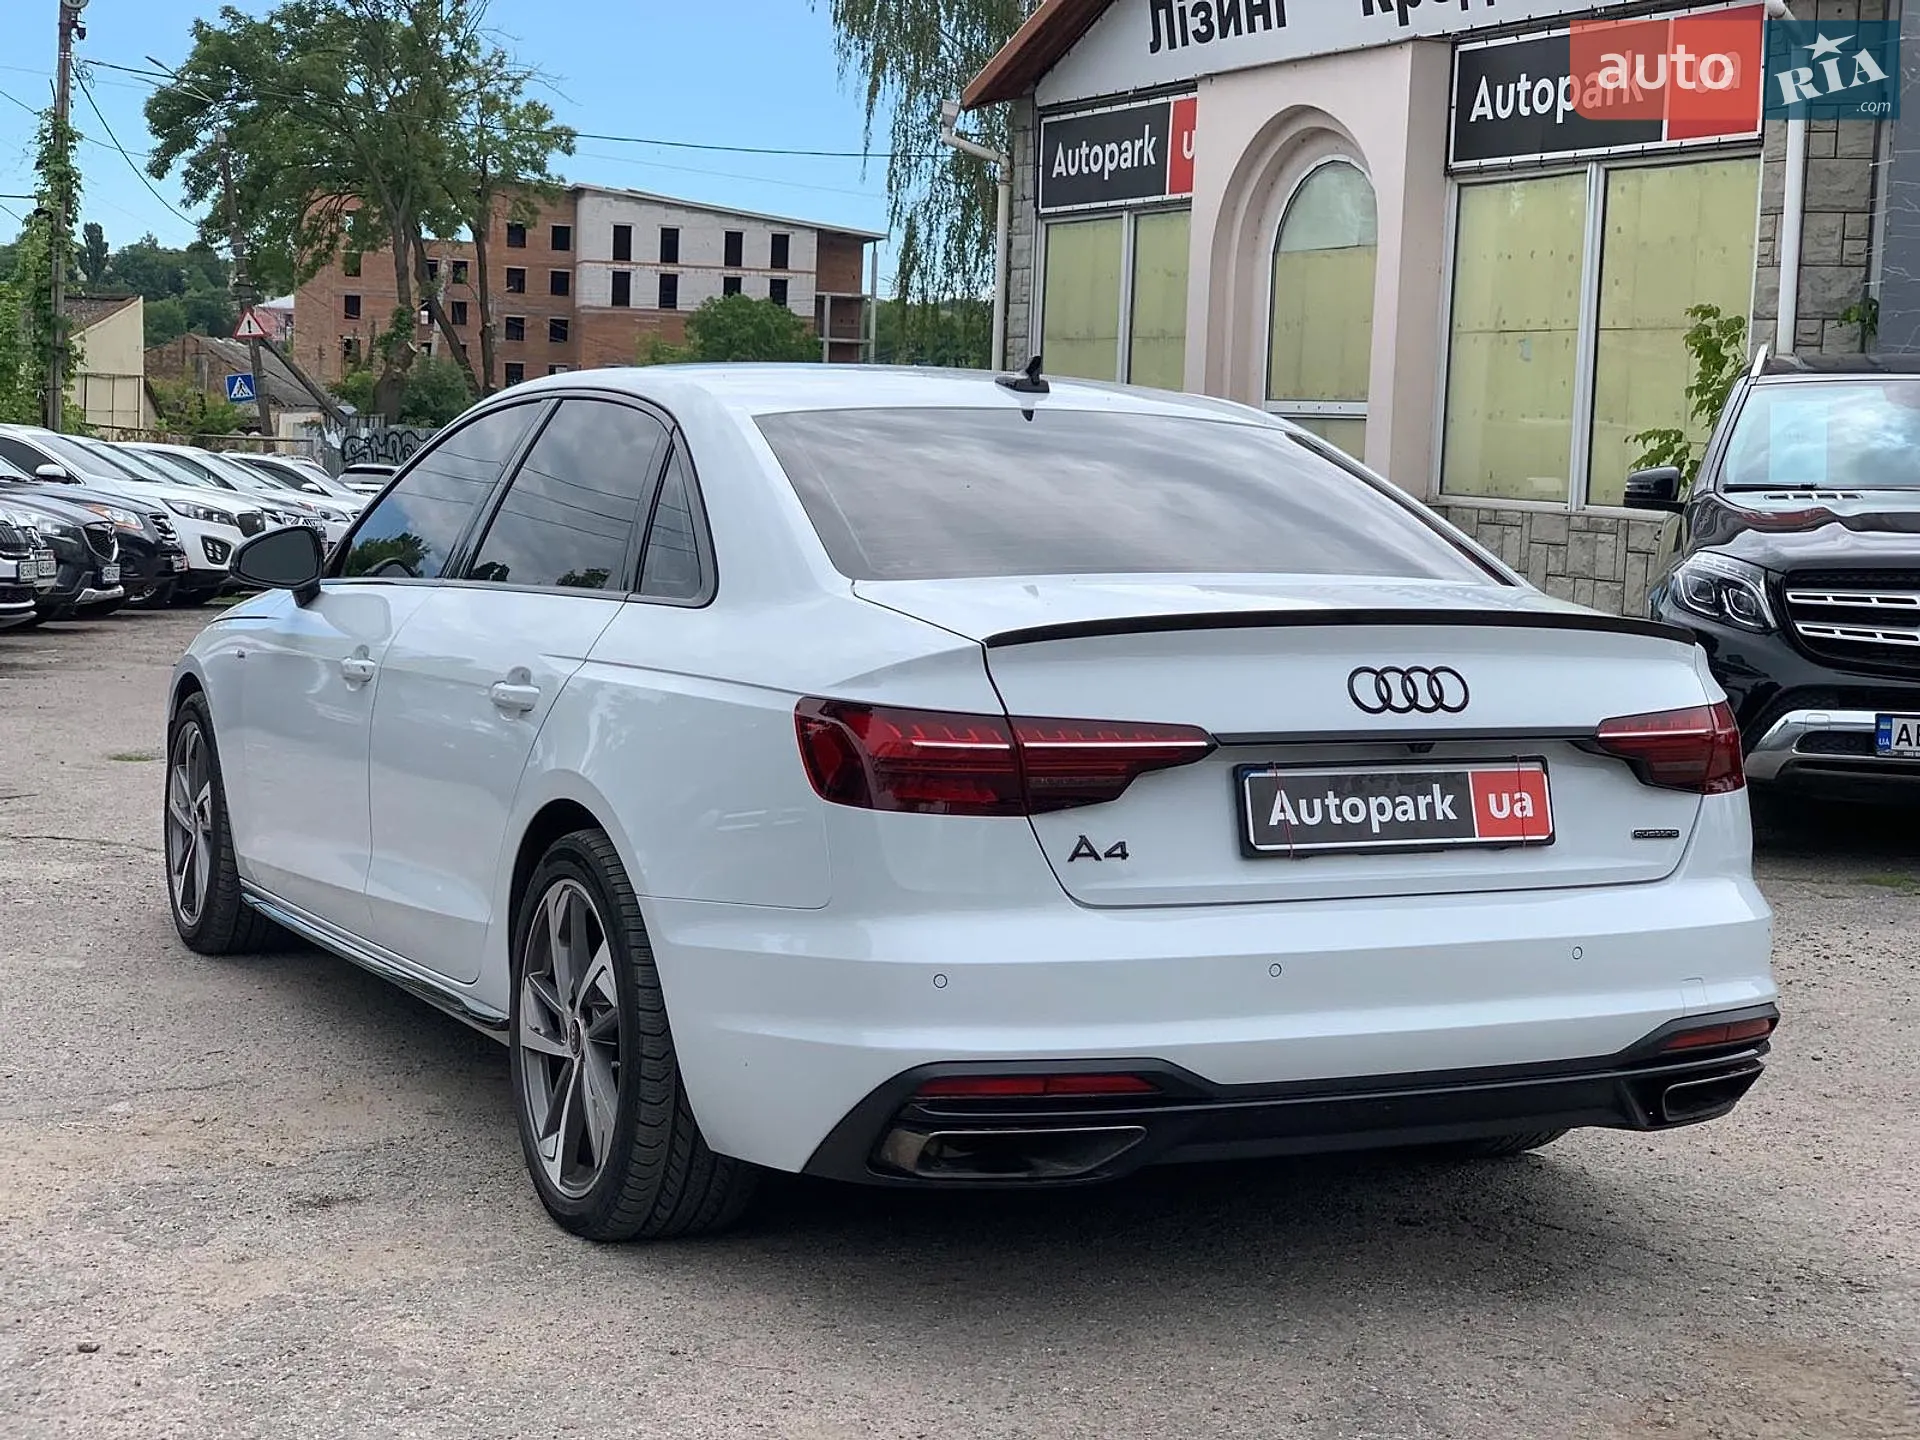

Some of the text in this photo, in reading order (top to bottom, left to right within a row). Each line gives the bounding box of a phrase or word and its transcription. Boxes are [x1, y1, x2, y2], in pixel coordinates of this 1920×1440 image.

[1469, 49, 1645, 124] Autopark
[1051, 124, 1157, 183] Autopark
[1268, 783, 1535, 833] Autopark ua
[1067, 834, 1129, 862] A4
